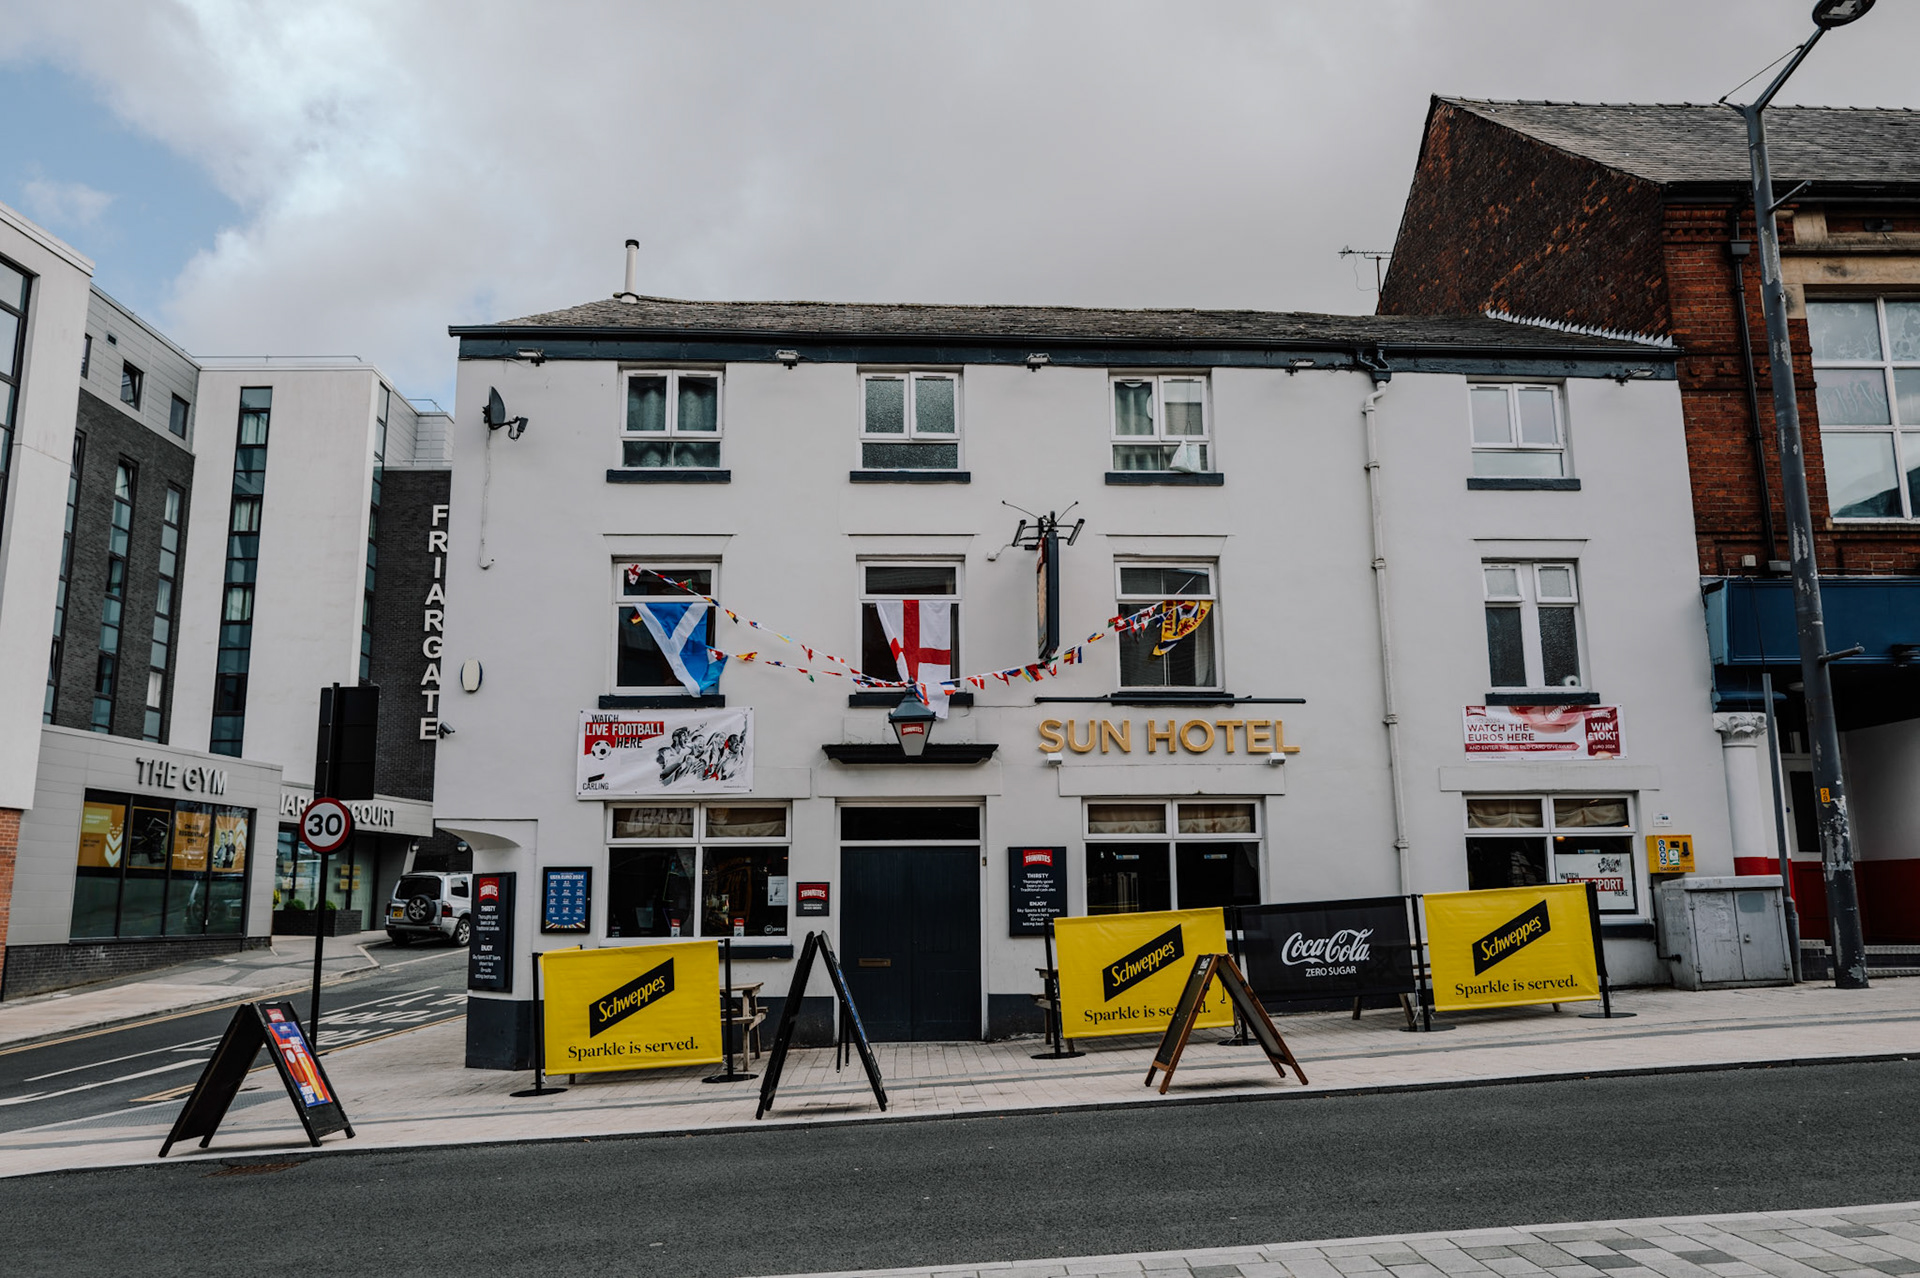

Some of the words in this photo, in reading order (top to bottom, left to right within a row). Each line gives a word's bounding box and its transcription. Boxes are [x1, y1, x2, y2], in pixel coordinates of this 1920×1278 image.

[420, 504, 449, 741] FRIARGATE
[586, 724, 608, 736] LIVE
[612, 723, 664, 736] FOOTBALL
[591, 714, 619, 723] WATCH
[1467, 724, 1504, 732] WATCH
[1591, 722, 1613, 730] WIN
[616, 737, 643, 748] HERE
[1038, 720, 1131, 753] SUN
[1148, 720, 1300, 753] HOTEL
[1468, 733, 1504, 741] EUROS
[1507, 733, 1535, 741] HERE
[136, 758, 178, 789] THE
[183, 767, 228, 795] GYM
[583, 782, 609, 790] CARLING
[308, 813, 342, 837] 30
[351, 803, 396, 827] COURT
[1281, 928, 1374, 966] Coca-Cola
[1480, 915, 1542, 961] Schweppes
[1112, 941, 1175, 986] Schweppes
[1305, 966, 1327, 978] ZERO
[1328, 965, 1357, 976] SUGAR
[1455, 980, 1510, 998] Sparkle
[1513, 978, 1524, 992] is
[1528, 974, 1579, 990] served.
[599, 975, 666, 1022] Schweppes
[1084, 1006, 1140, 1025] Sparkle
[1144, 1005, 1155, 1017] is
[568, 1042, 625, 1061] Sparkle
[630, 1041, 641, 1054] is
[645, 1036, 699, 1052] served.
